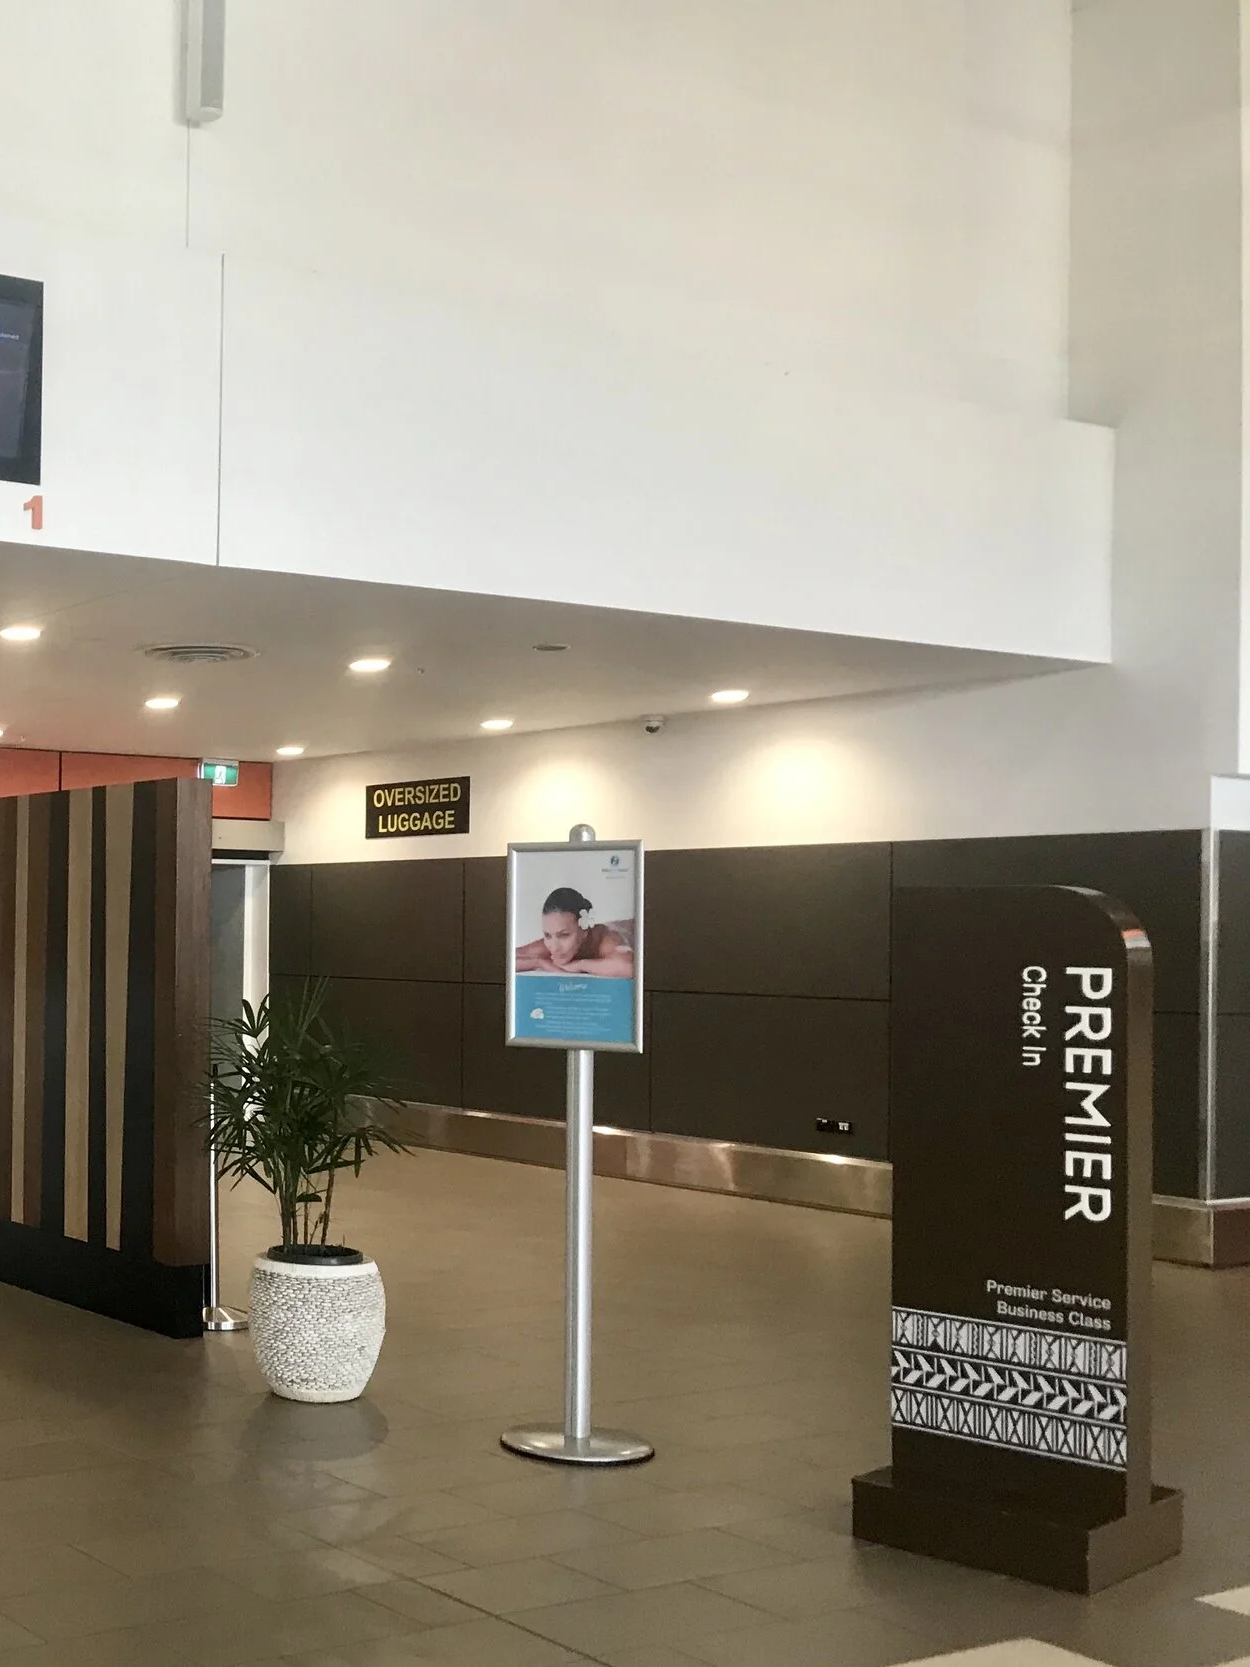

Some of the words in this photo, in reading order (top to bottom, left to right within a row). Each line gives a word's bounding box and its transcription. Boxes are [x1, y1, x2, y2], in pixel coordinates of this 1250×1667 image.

[23, 495, 43, 530] 1
[373, 783, 461, 808] OVERSIZED
[378, 810, 455, 833] LUGGAGE
[1021, 965, 1047, 1039] Check
[1022, 1047, 1047, 1067] In
[1064, 966, 1113, 1224] PREMIER
[986, 1279, 1048, 1300] Premier
[1051, 1288, 1111, 1310] Service
[996, 1300, 1064, 1323] Business
[1068, 1311, 1111, 1331] Class
